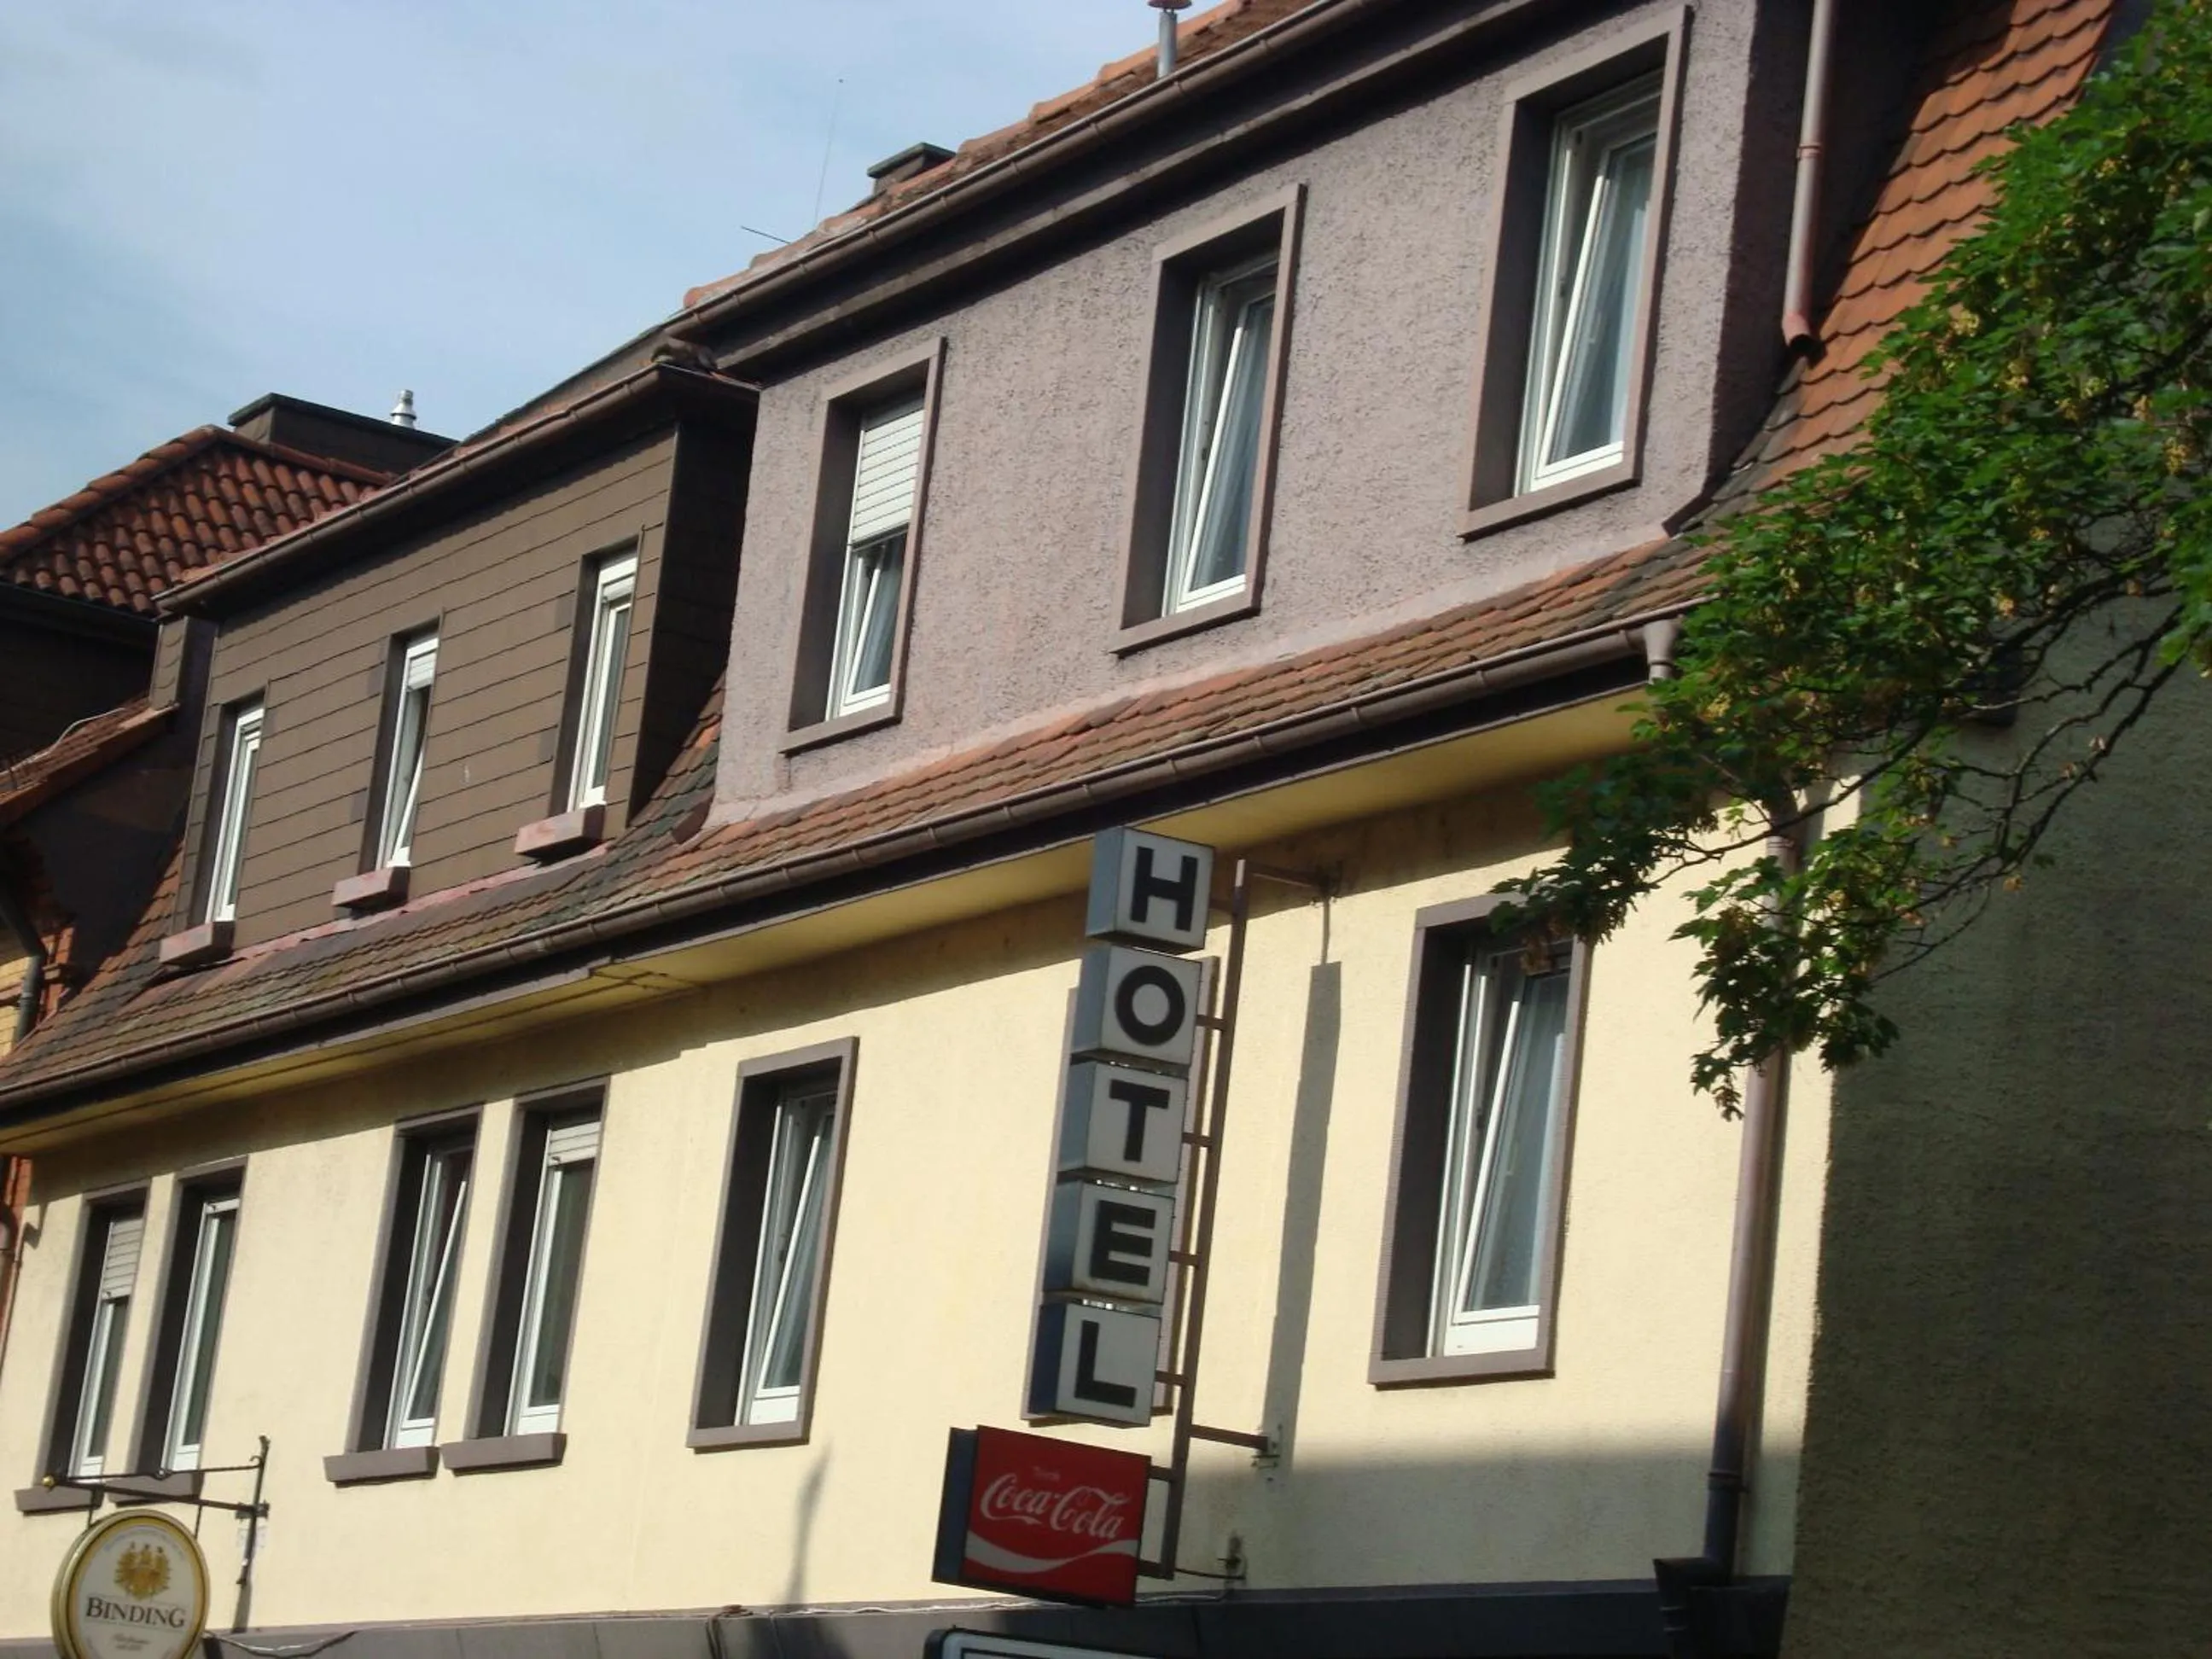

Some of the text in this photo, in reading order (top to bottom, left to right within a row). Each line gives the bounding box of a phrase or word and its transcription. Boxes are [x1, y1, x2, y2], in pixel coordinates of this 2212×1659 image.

[1074, 846, 1198, 1409] HOTEL
[980, 1473, 1130, 1540] Coca-Cola
[86, 1597, 185, 1628] BINDING
